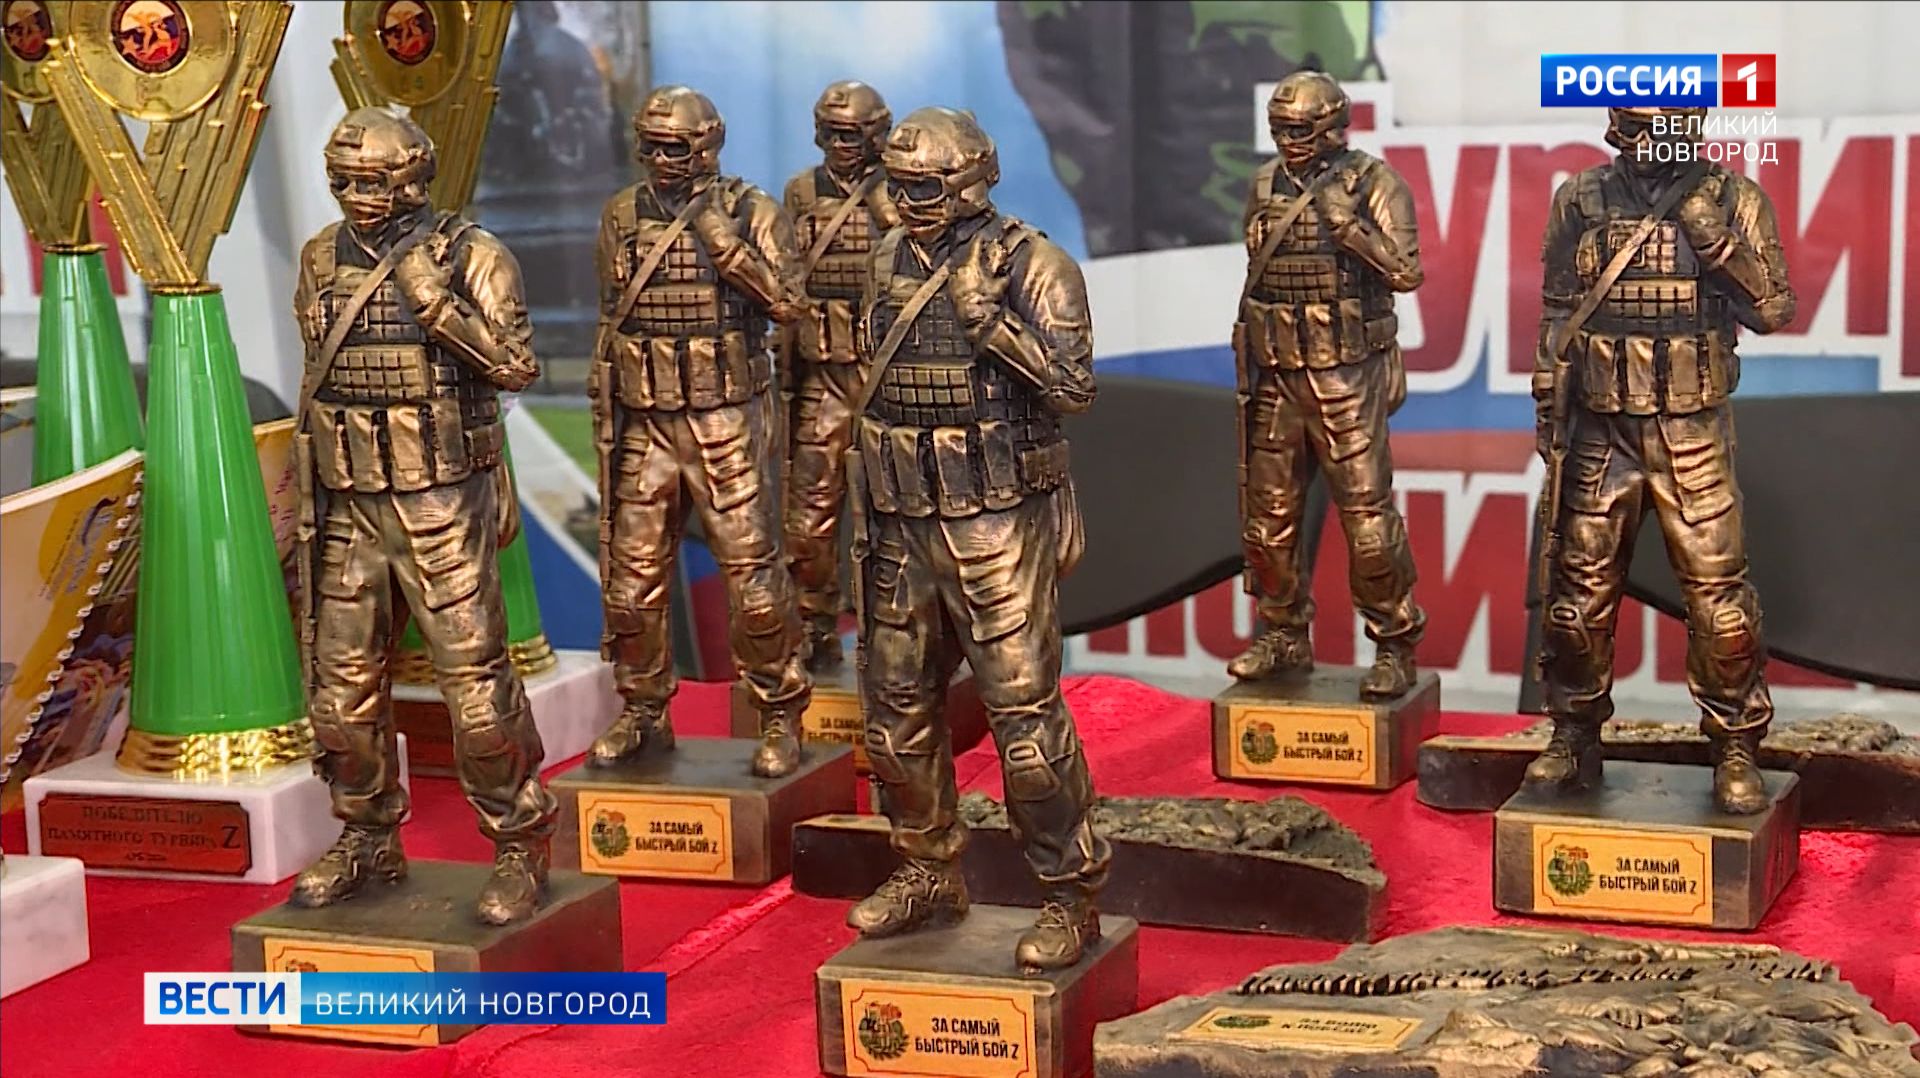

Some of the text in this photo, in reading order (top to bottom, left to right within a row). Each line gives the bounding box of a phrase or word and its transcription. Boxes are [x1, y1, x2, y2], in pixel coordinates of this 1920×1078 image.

[1296, 730, 1350, 745] ЗА САМЫЙ
[1283, 746, 1363, 763] БЫСТРЫЙ БОЙ Z
[220, 825, 242, 849] Z
[648, 820, 704, 835] ЗА САМЫЙ
[635, 837, 719, 854] БЫСТРЫЙ БОЙ Z
[1615, 856, 1680, 875] ЗА САМЫЙ
[1599, 874, 1697, 895] БЫСТРЫЙ БОЙ Z
[931, 1017, 1001, 1037] ЗА САМЫЙ
[914, 1037, 1019, 1060] БЫСТРЫЙ БОЙ Z
